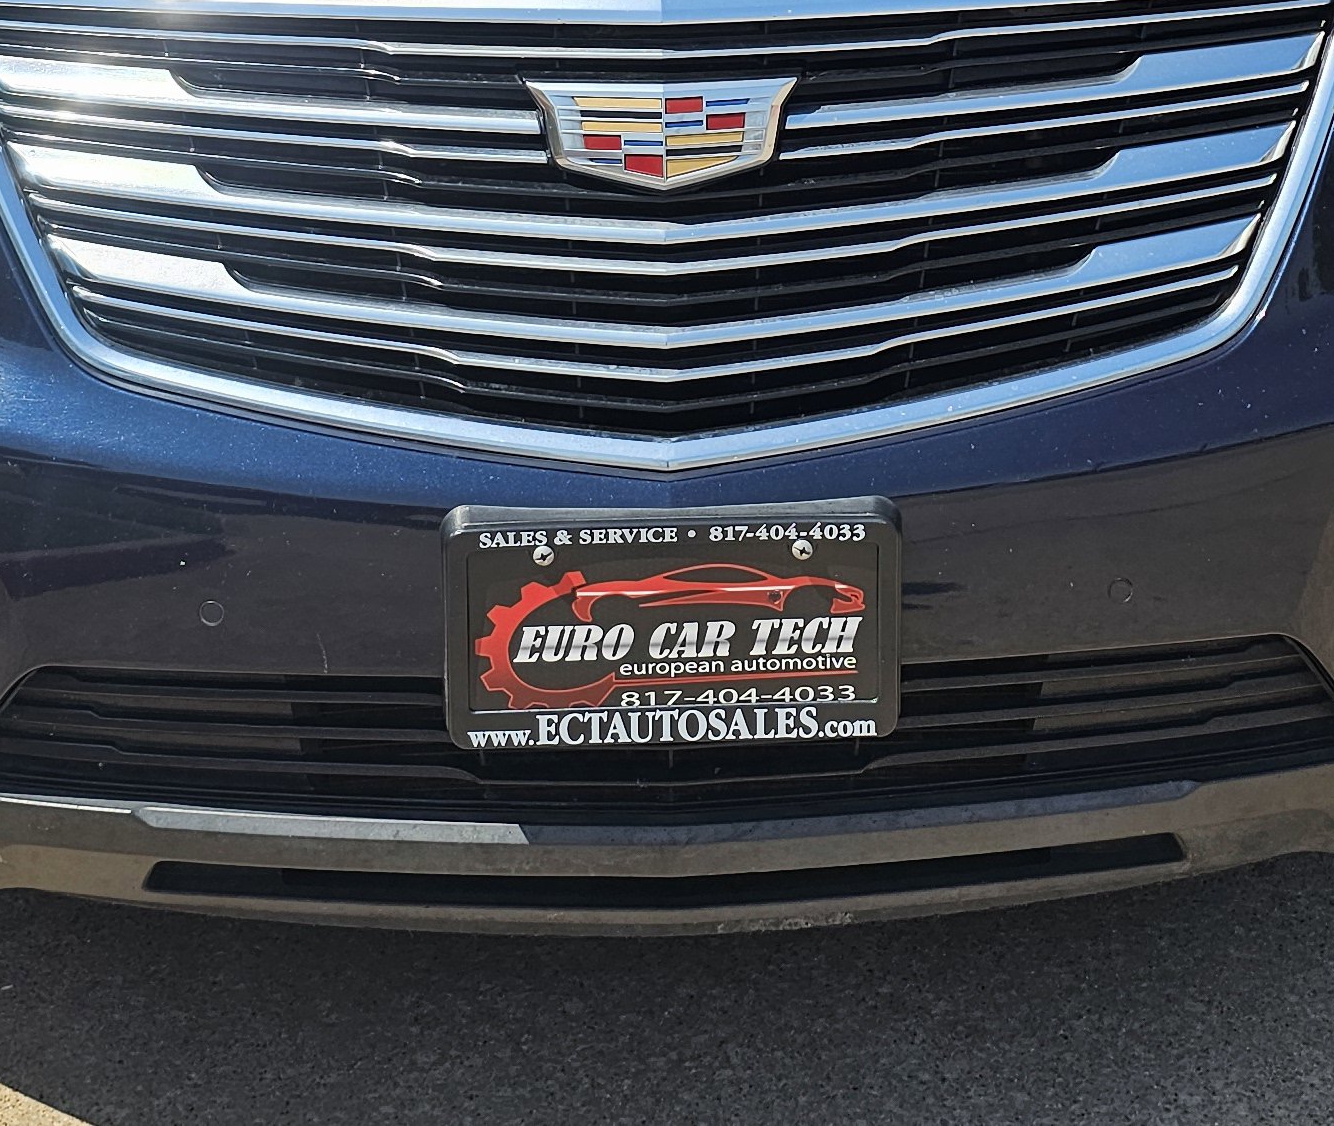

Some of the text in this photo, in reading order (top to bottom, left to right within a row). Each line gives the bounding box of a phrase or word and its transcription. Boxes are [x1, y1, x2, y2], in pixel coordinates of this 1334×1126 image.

[479, 522, 866, 549] SALES & SERVICE 817-404-4033
[513, 616, 863, 663] EURO CAR TECH
[620, 653, 857, 677] european automotive
[620, 685, 856, 708] 817-404-4033
[467, 707, 877, 749] www.ECTAUTOSALES.com
